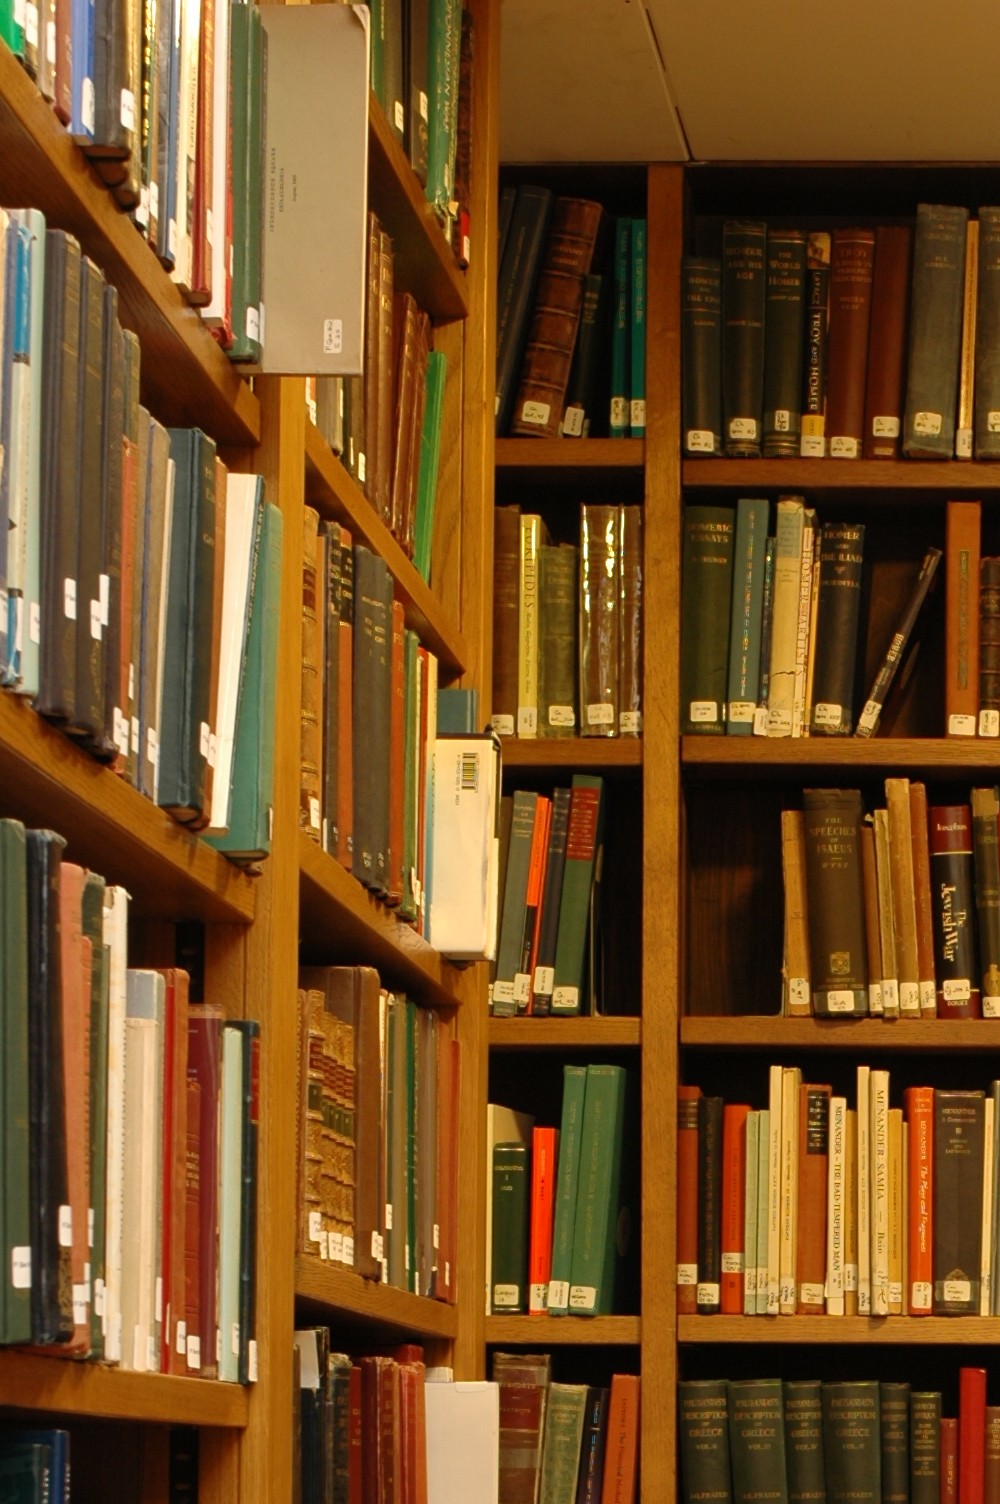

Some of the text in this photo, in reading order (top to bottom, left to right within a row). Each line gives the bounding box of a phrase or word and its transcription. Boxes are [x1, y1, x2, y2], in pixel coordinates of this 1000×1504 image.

[810, 312, 822, 344] TROY
[809, 366, 822, 412] HOMER
[824, 531, 861, 541] HOMER
[524, 526, 535, 608] EURIPIDES
[940, 882, 959, 963] Jewish War
[954, 908, 967, 928] The
[919, 1119, 928, 1161] MENANDER
[831, 1105, 844, 1273] MENANDER THE BAD-TEMPERED MAN
[876, 1162, 886, 1200] SAMIA
